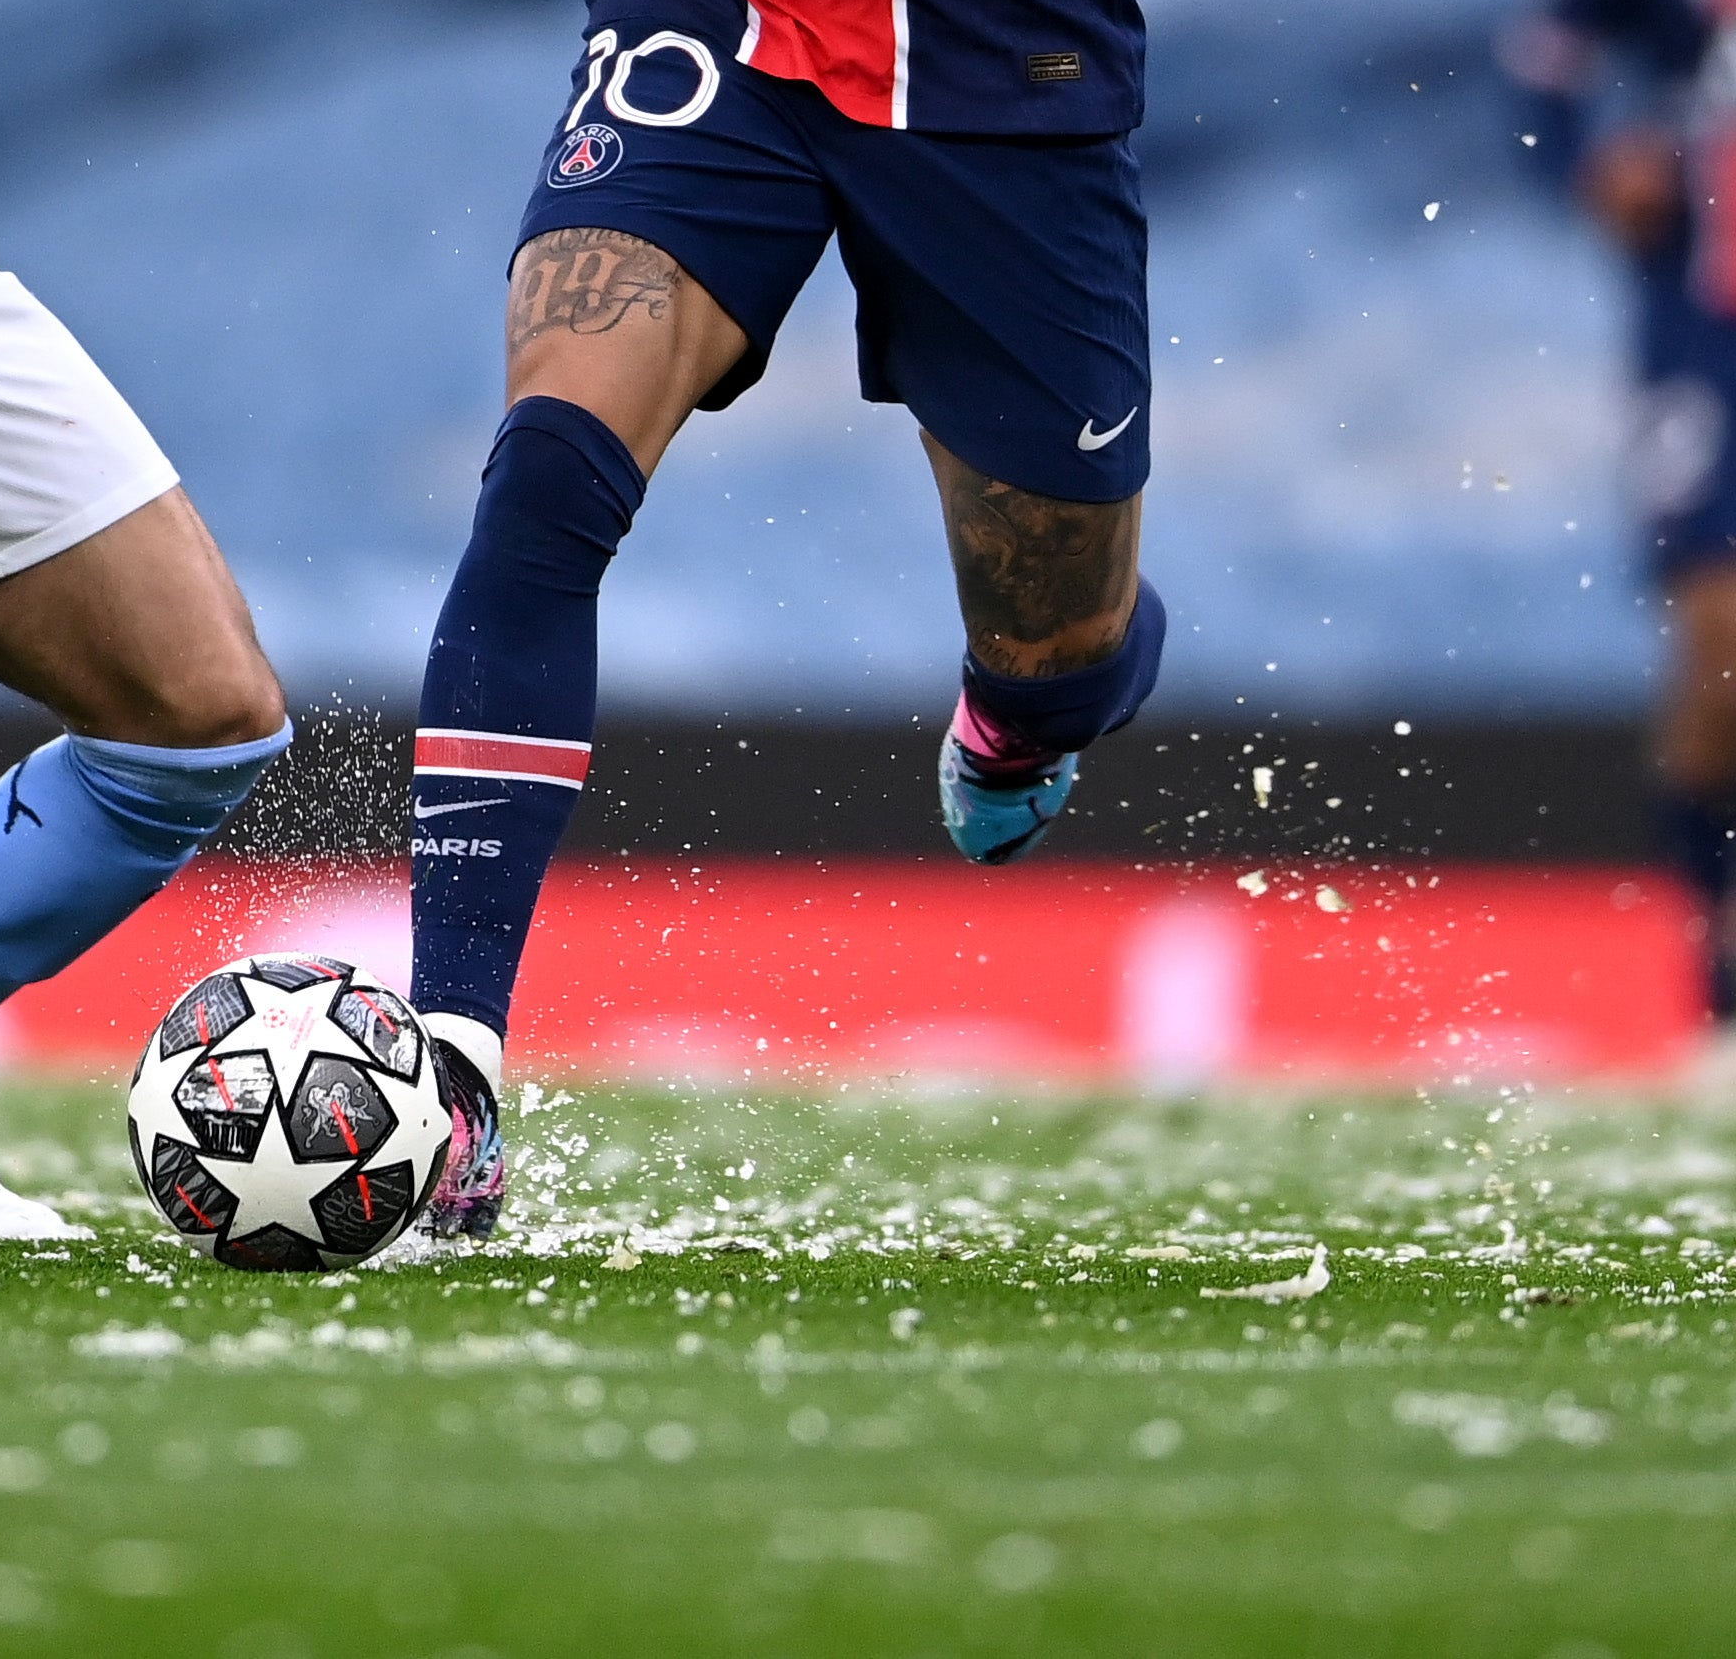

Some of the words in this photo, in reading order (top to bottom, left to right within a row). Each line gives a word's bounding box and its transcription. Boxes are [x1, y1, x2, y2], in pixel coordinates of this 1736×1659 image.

[564, 28, 721, 133] 10
[566, 127, 615, 147] PARIS
[410, 837, 504, 858] PARIS
